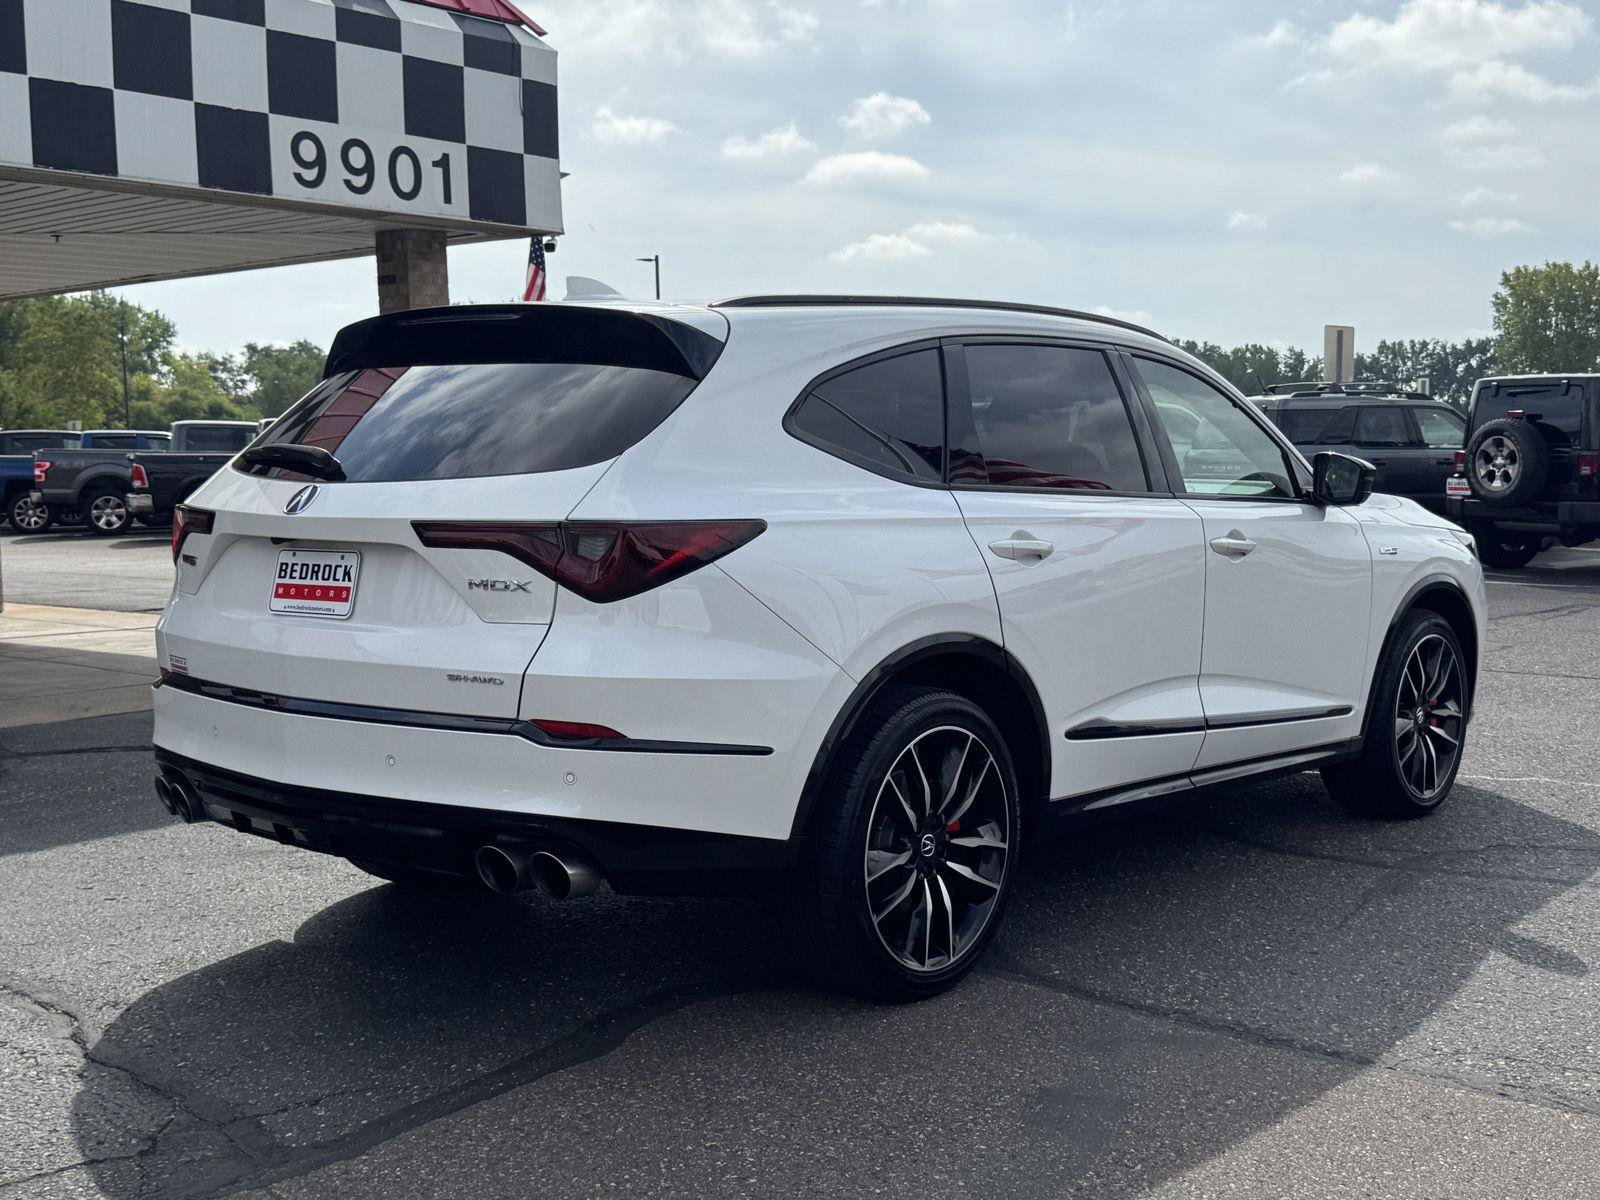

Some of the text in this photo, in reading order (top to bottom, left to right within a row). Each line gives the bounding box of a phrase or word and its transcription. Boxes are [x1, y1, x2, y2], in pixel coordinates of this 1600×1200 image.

[290, 130, 452, 205] 9901
[277, 562, 353, 583] BEDROCK
[277, 587, 348, 598] MOTORS
[467, 578, 532, 593] MDX
